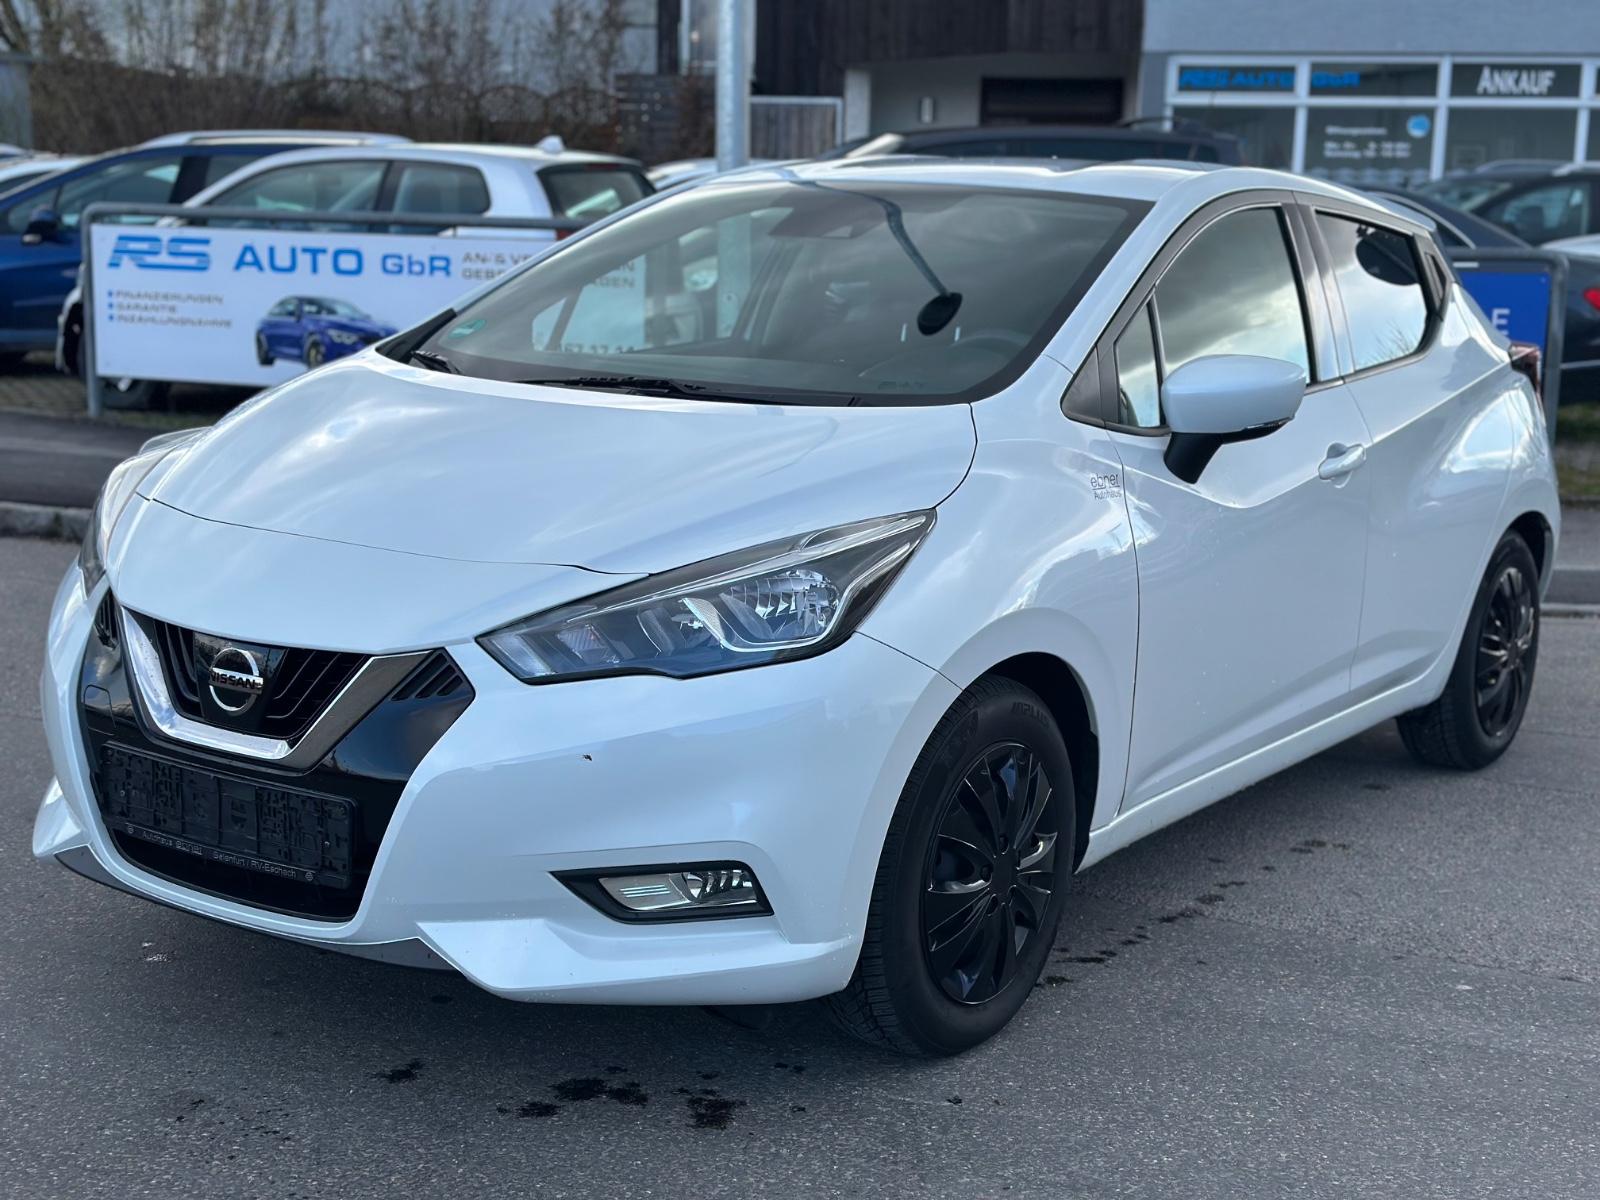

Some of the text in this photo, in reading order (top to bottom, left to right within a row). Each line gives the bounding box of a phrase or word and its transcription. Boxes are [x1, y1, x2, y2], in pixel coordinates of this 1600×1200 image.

[1476, 66, 1555, 95] ANKAUF
[108, 235, 452, 277] RS AUTO GbR
[1090, 473, 1120, 488] ebner
[209, 670, 257, 690] NISSAN
